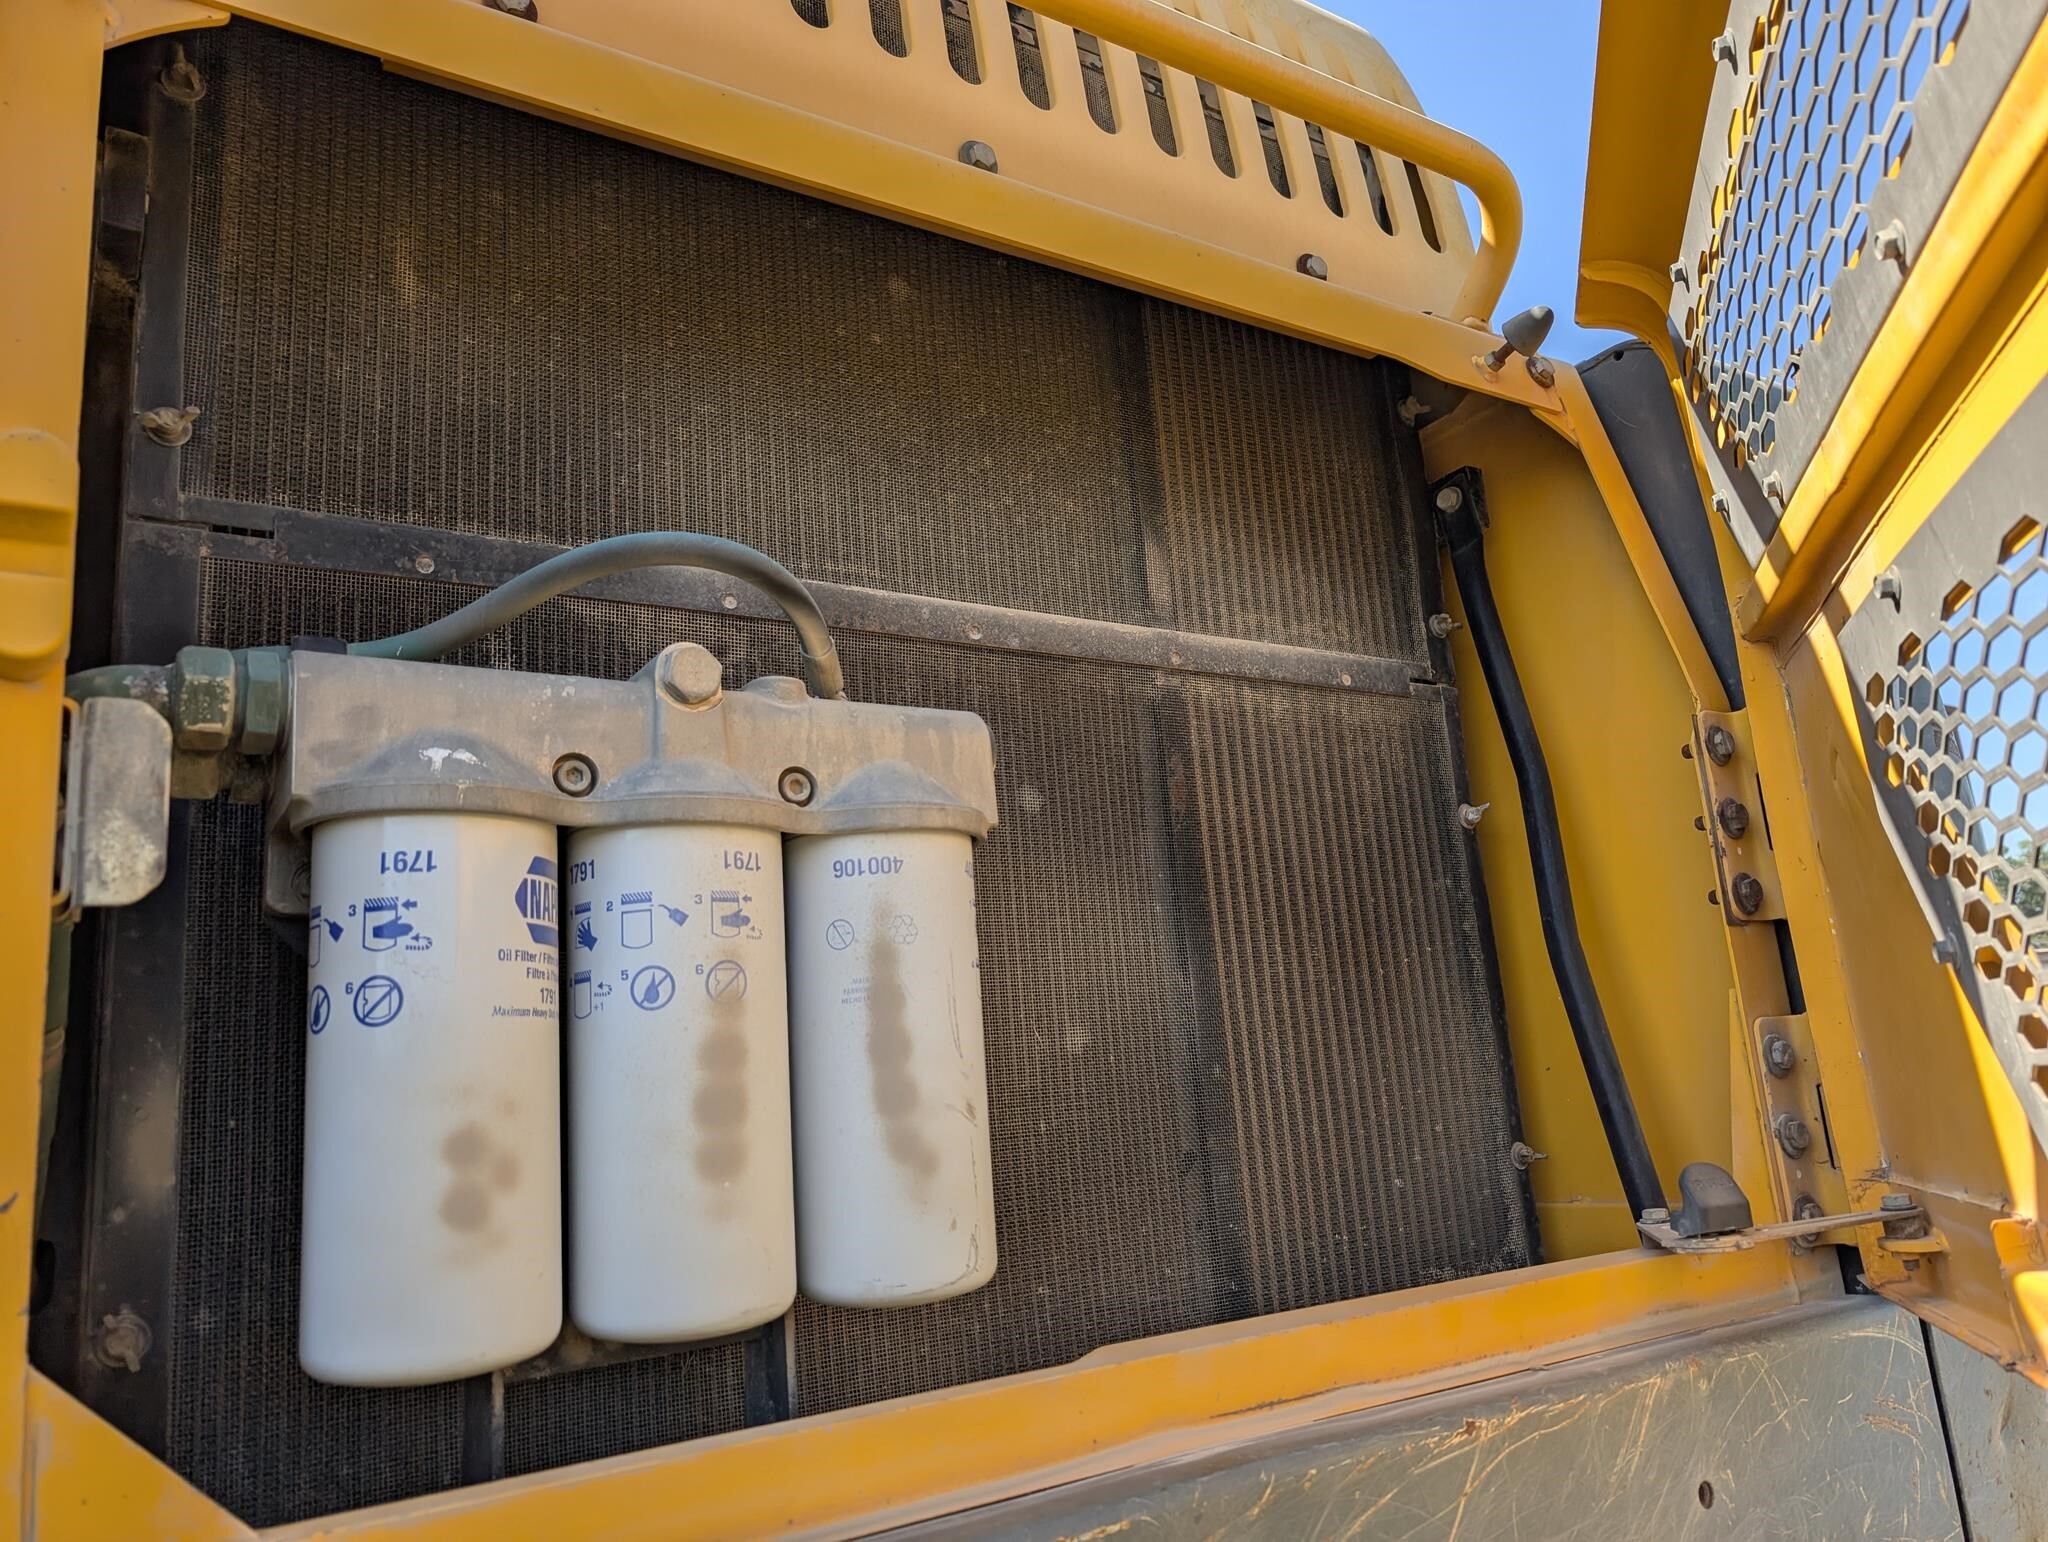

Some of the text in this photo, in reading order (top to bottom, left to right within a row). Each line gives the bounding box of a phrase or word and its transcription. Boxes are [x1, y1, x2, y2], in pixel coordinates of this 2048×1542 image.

[380, 850, 437, 874] 1791
[723, 850, 761, 872] 1791
[569, 859, 595, 885] 1791
[530, 878, 558, 926] NAP
[606, 901, 614, 912] 2
[694, 894, 703, 905] 3
[347, 904, 357, 917] 3
[498, 948, 512, 961] Oil
[514, 949, 537, 962] Filter
[526, 967, 546, 981] Filtre
[621, 970, 629, 981] 5
[695, 964, 704, 975] 6
[345, 982, 354, 995] 6
[540, 987, 557, 1006] 1791
[491, 1003, 531, 1017] Maximum
[531, 1007, 548, 1019] Heavy
